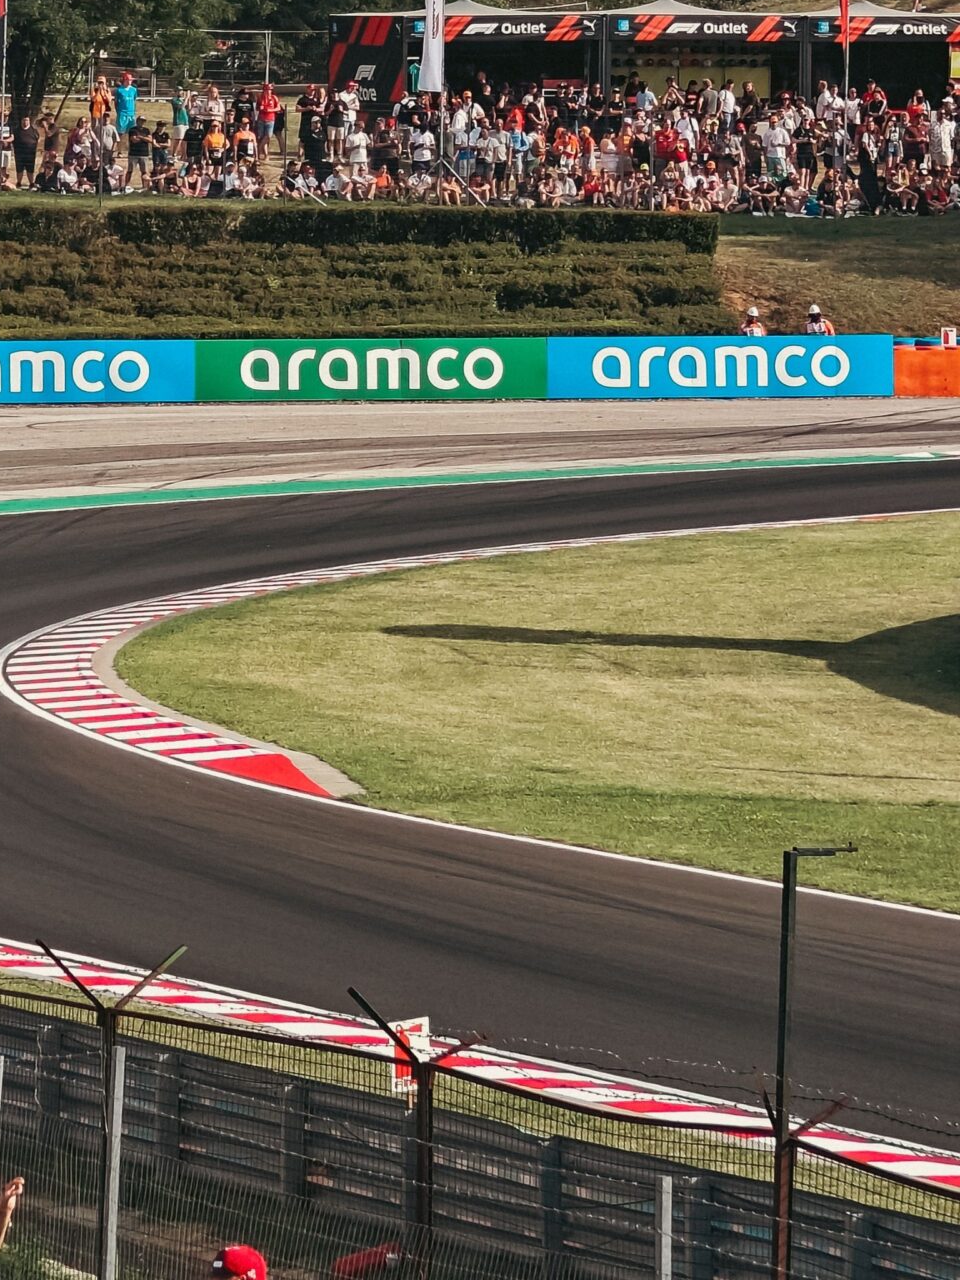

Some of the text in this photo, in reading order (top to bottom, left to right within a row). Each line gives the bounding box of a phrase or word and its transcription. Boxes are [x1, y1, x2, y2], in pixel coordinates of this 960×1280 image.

[501, 22, 547, 35] Outlet
[703, 22, 748, 34] Outlet
[902, 23, 948, 35] Outlet
[358, 85, 377, 101] tore
[240, 348, 504, 391] aramco
[592, 346, 850, 388] aramco
